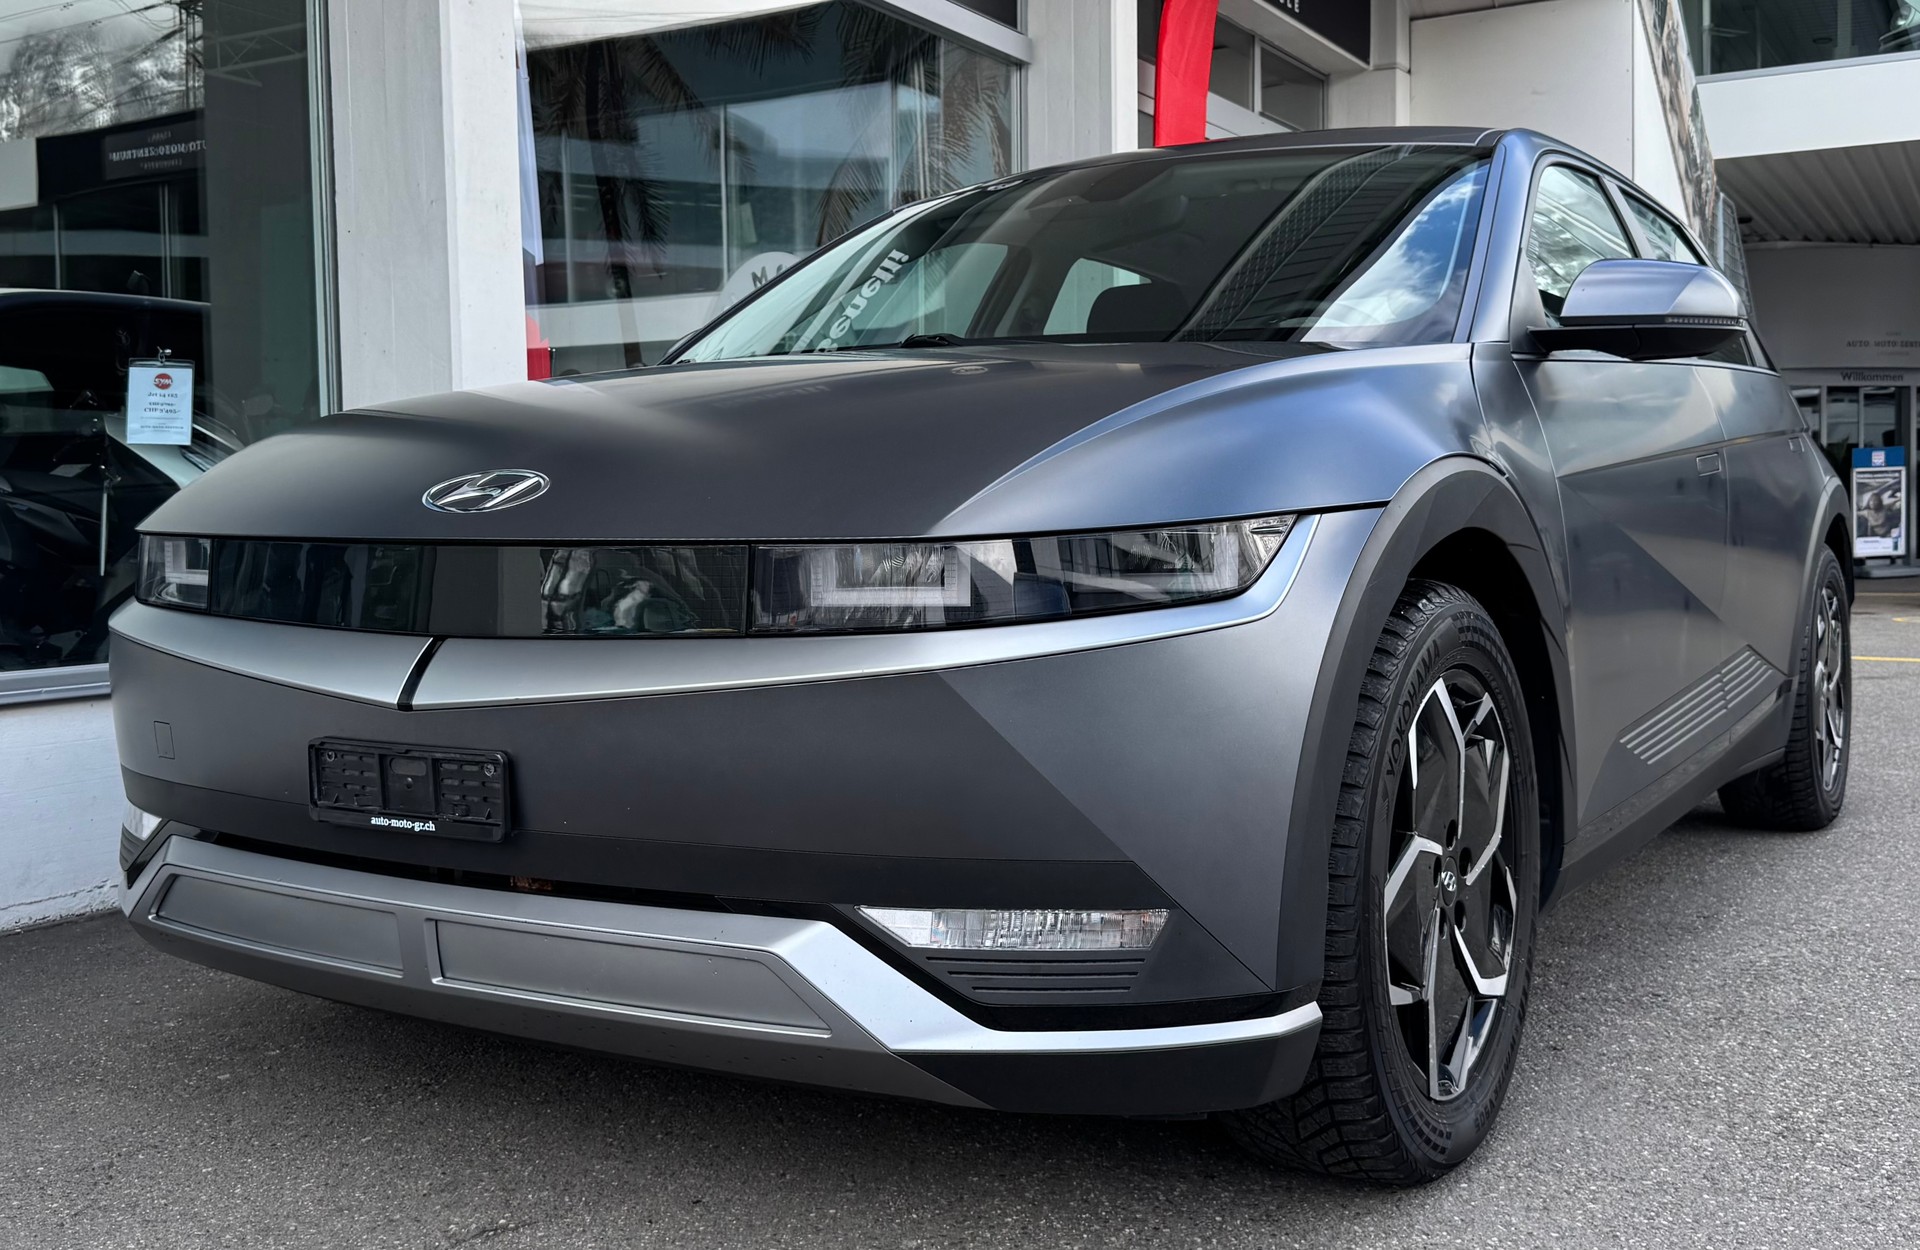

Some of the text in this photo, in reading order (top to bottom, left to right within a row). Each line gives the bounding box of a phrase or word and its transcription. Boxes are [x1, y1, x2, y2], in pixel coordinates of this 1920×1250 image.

[1840, 371, 1904, 382] Willkommen
[1386, 639, 1440, 777] YOKOHAMA
[370, 816, 436, 832] auto-moto-gr.ch
